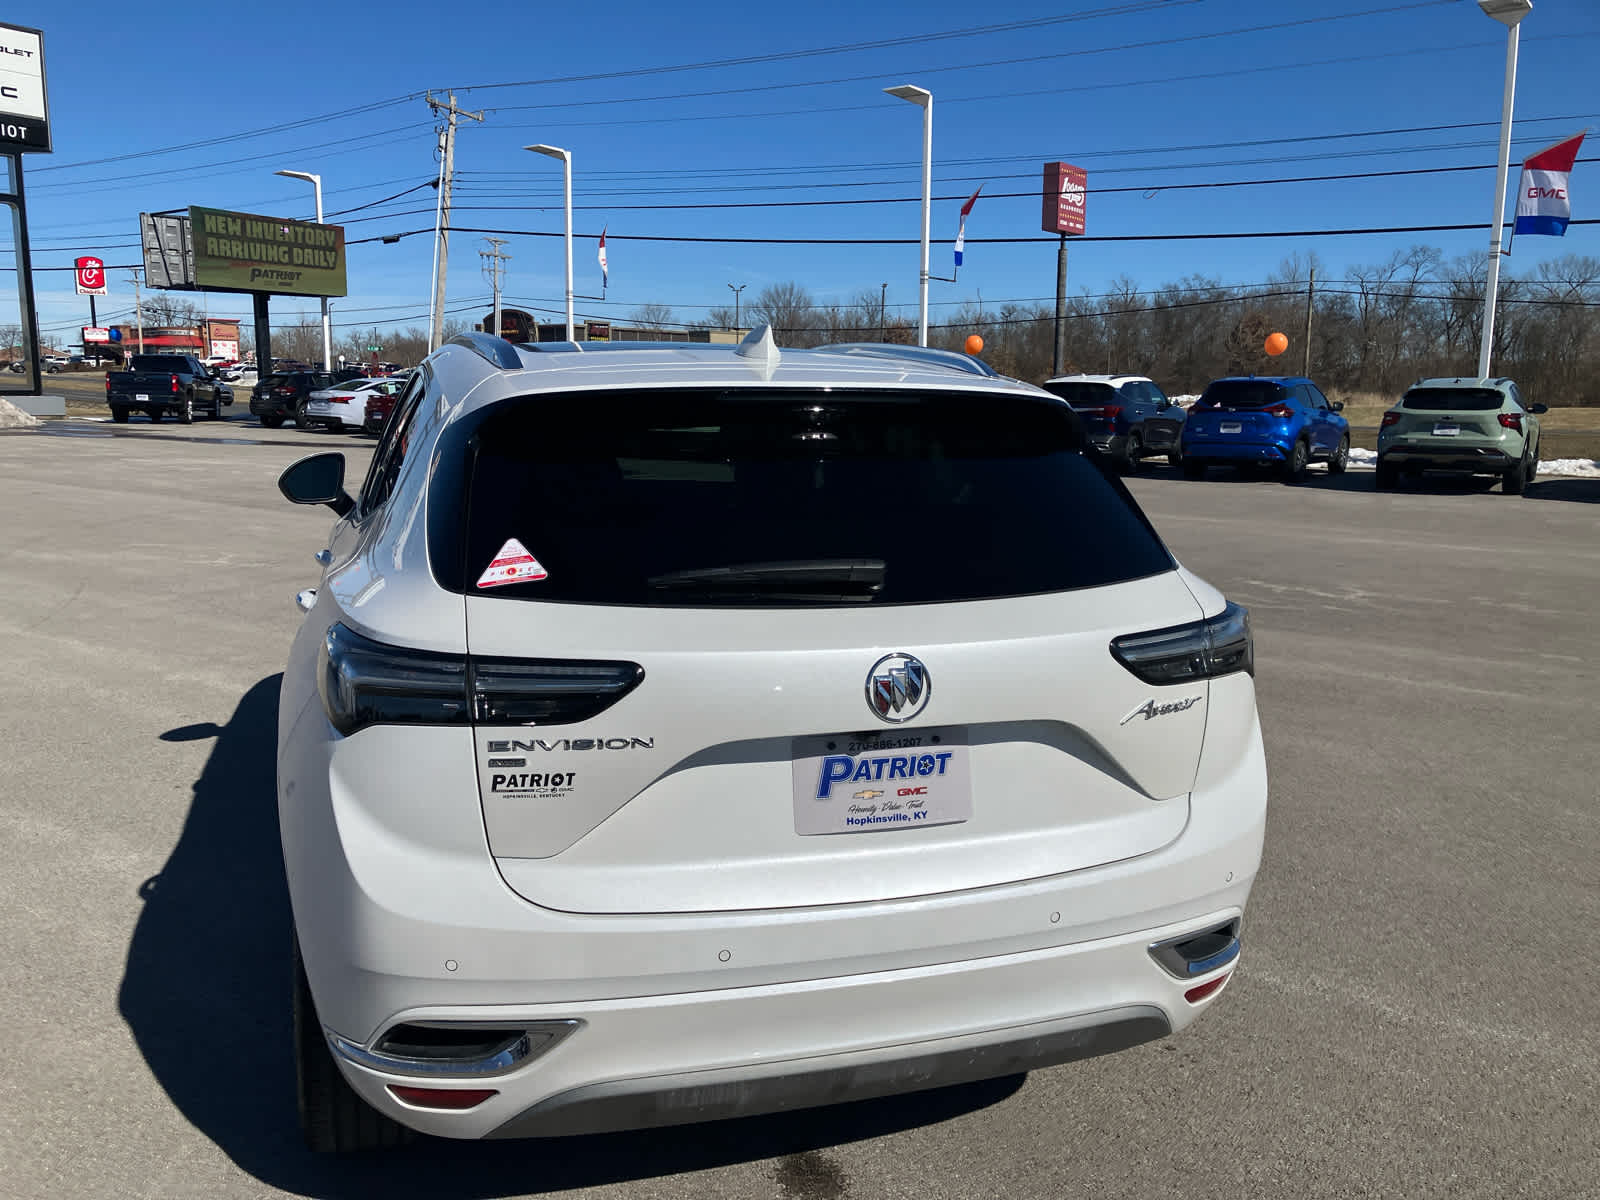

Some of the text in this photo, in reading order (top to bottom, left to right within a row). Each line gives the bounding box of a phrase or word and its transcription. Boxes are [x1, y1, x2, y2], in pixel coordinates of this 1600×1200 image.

[1528, 187, 1566, 199] GMC
[204, 214, 336, 247] NEW INVENTORY
[207, 237, 336, 269] ARRIVING DAILY
[250, 268, 302, 282] PATRIOT
[487, 737, 654, 752] ENVISION
[491, 772, 576, 792] PATRIOT
[816, 752, 953, 800] PATRIOT
[897, 786, 928, 797] GMC
[846, 810, 928, 826] Hopkinsville, KY
